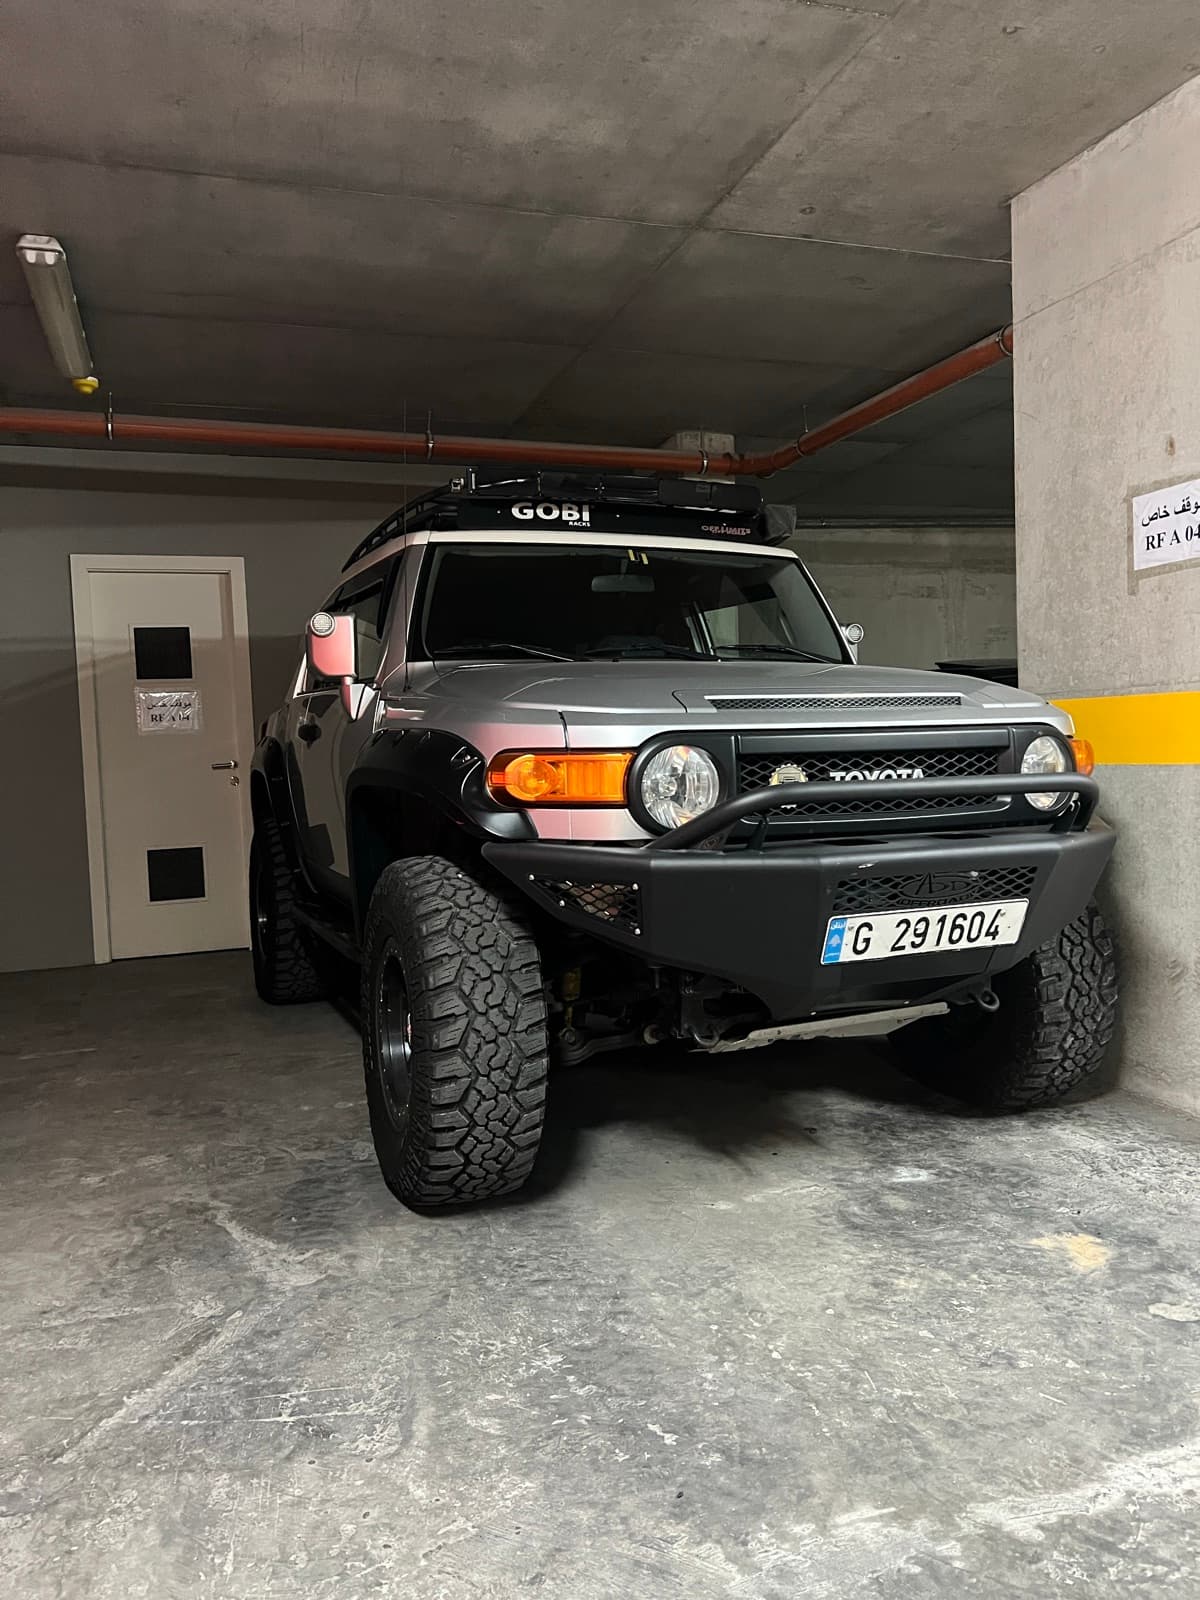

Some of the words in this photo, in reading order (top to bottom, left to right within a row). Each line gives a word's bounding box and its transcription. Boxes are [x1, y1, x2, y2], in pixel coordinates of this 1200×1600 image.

[511, 502, 590, 522] GOBI
[1141, 505, 1170, 527] خاص
[1174, 496, 1200, 515] وقف
[1145, 532, 1166, 551] RF
[1169, 529, 1182, 546] A
[829, 768, 925, 782] TOYOTA
[852, 921, 873, 956] G
[890, 909, 1002, 953] 291604
